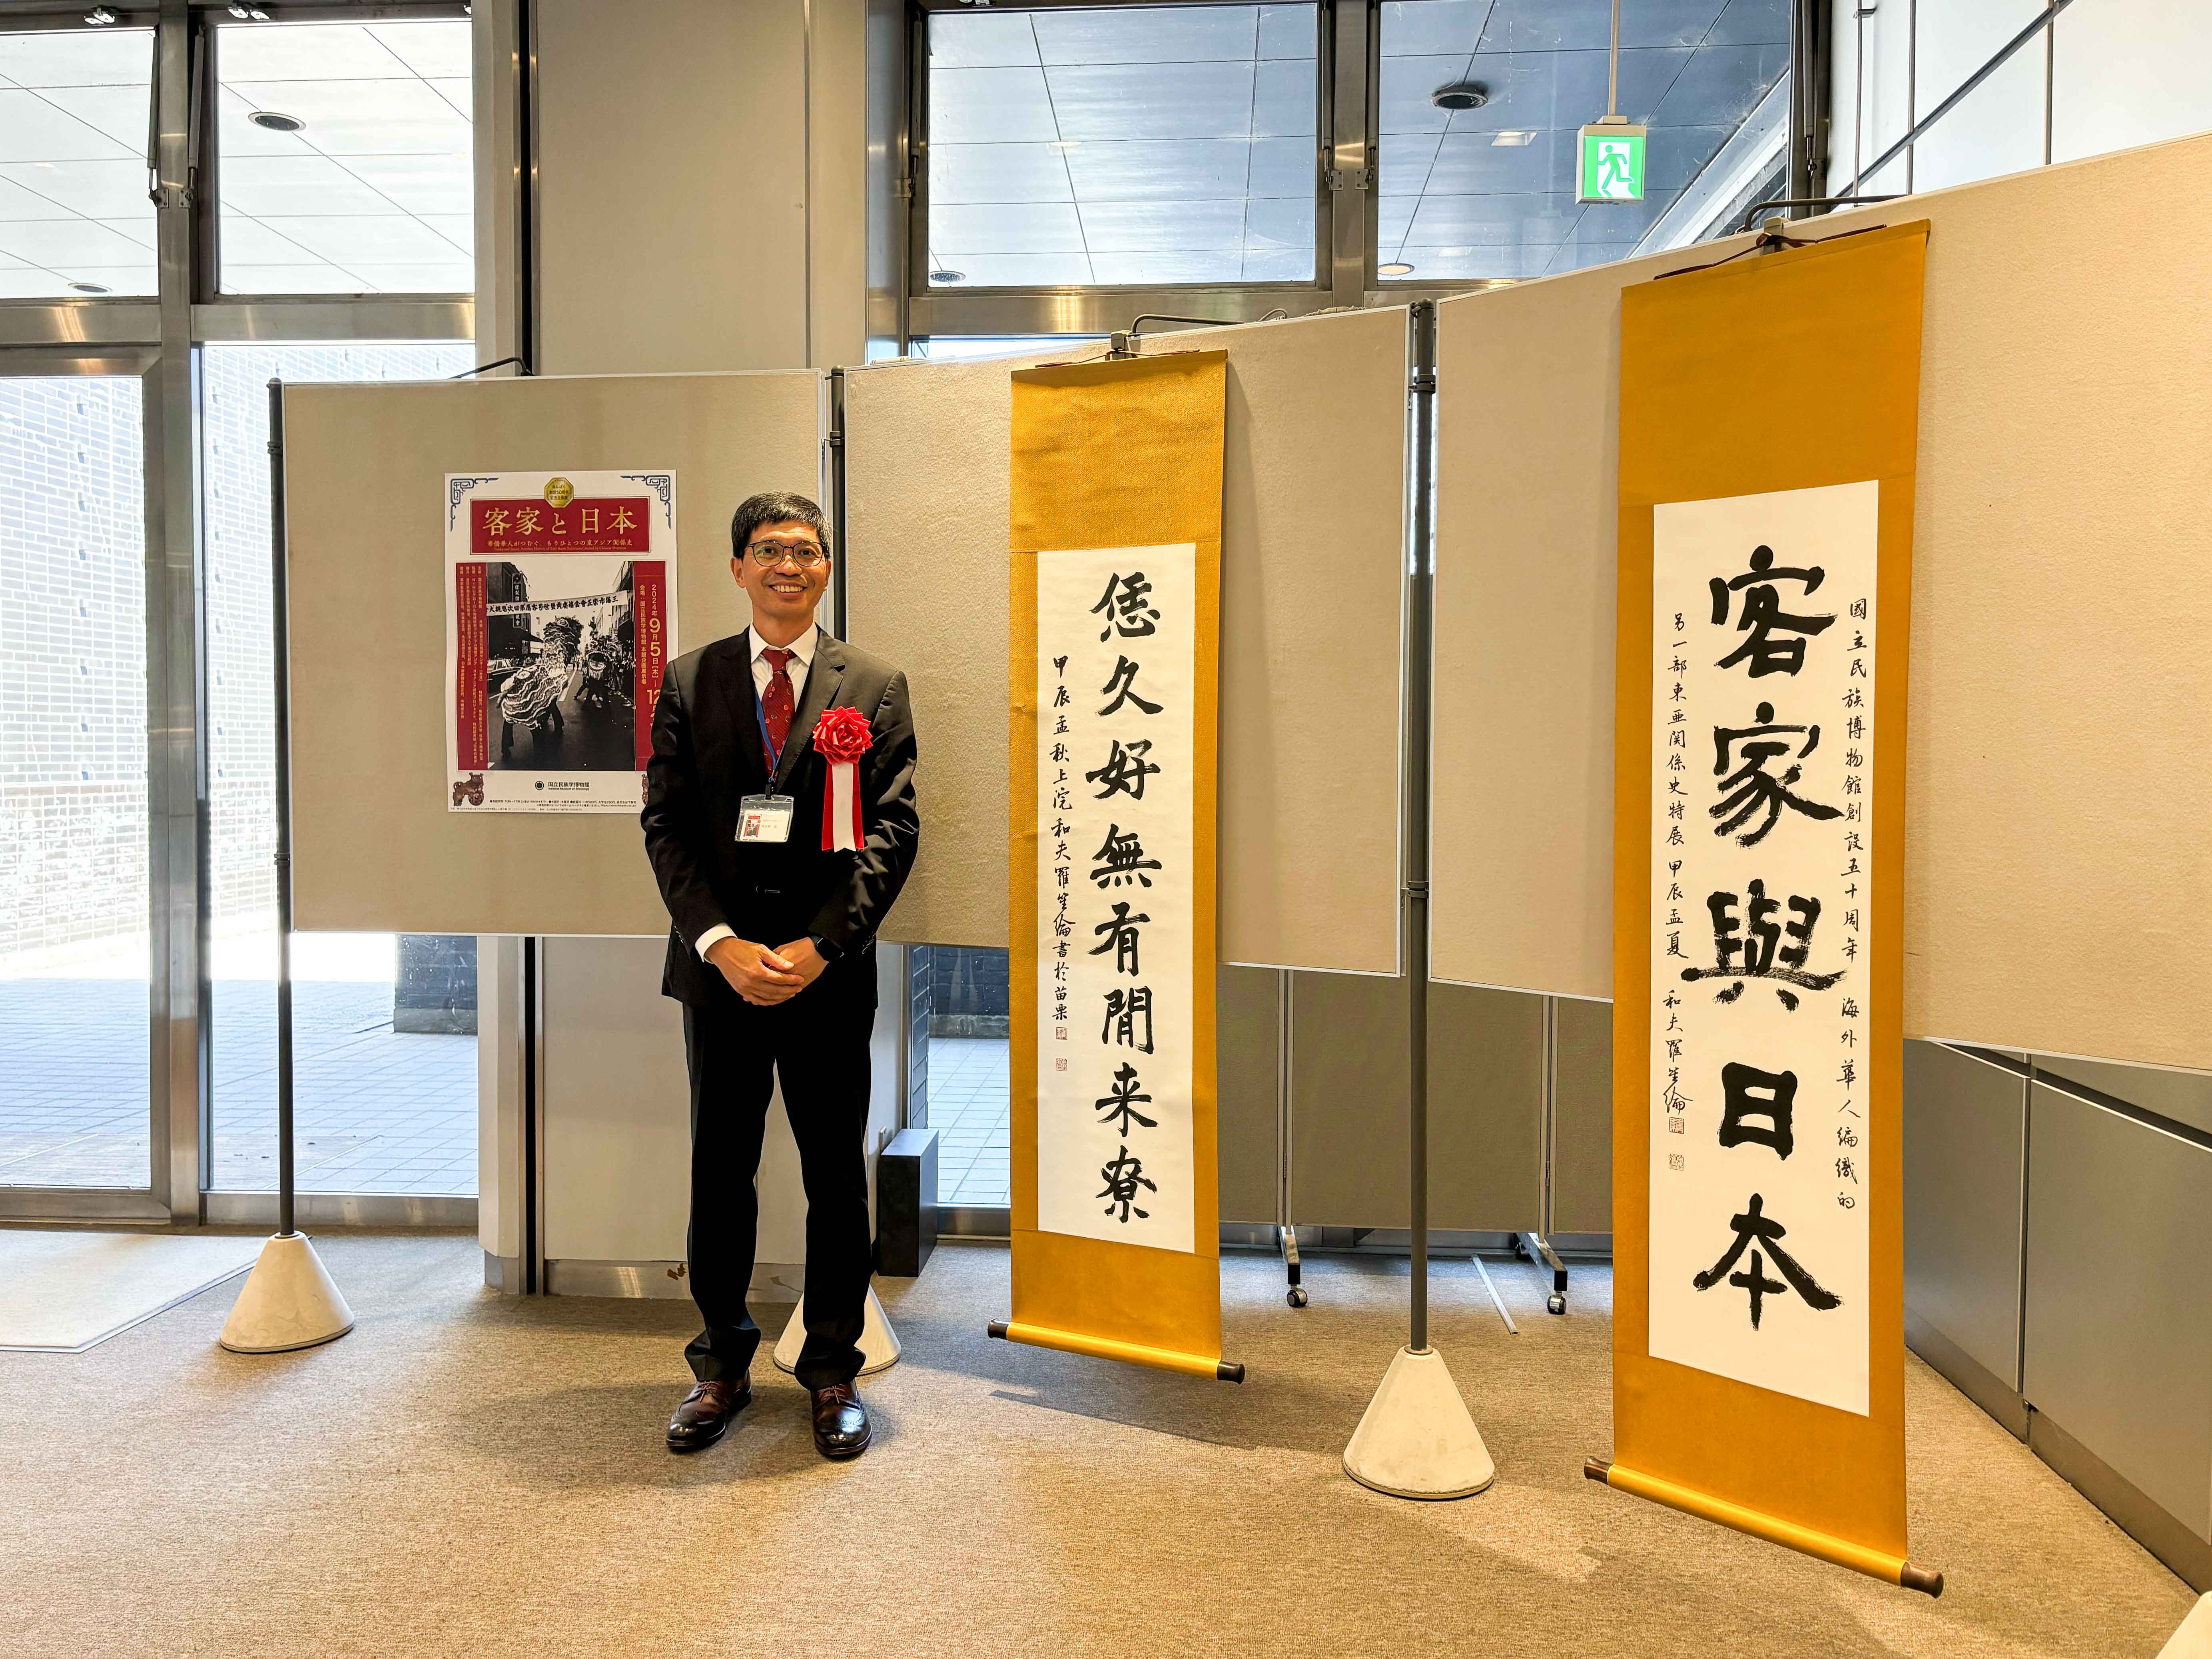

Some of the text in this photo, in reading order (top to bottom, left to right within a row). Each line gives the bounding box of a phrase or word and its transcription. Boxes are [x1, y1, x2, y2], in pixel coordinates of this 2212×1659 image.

[482, 506, 638, 536] 客家と日本
[1681, 545, 1848, 1330] 客家與日本
